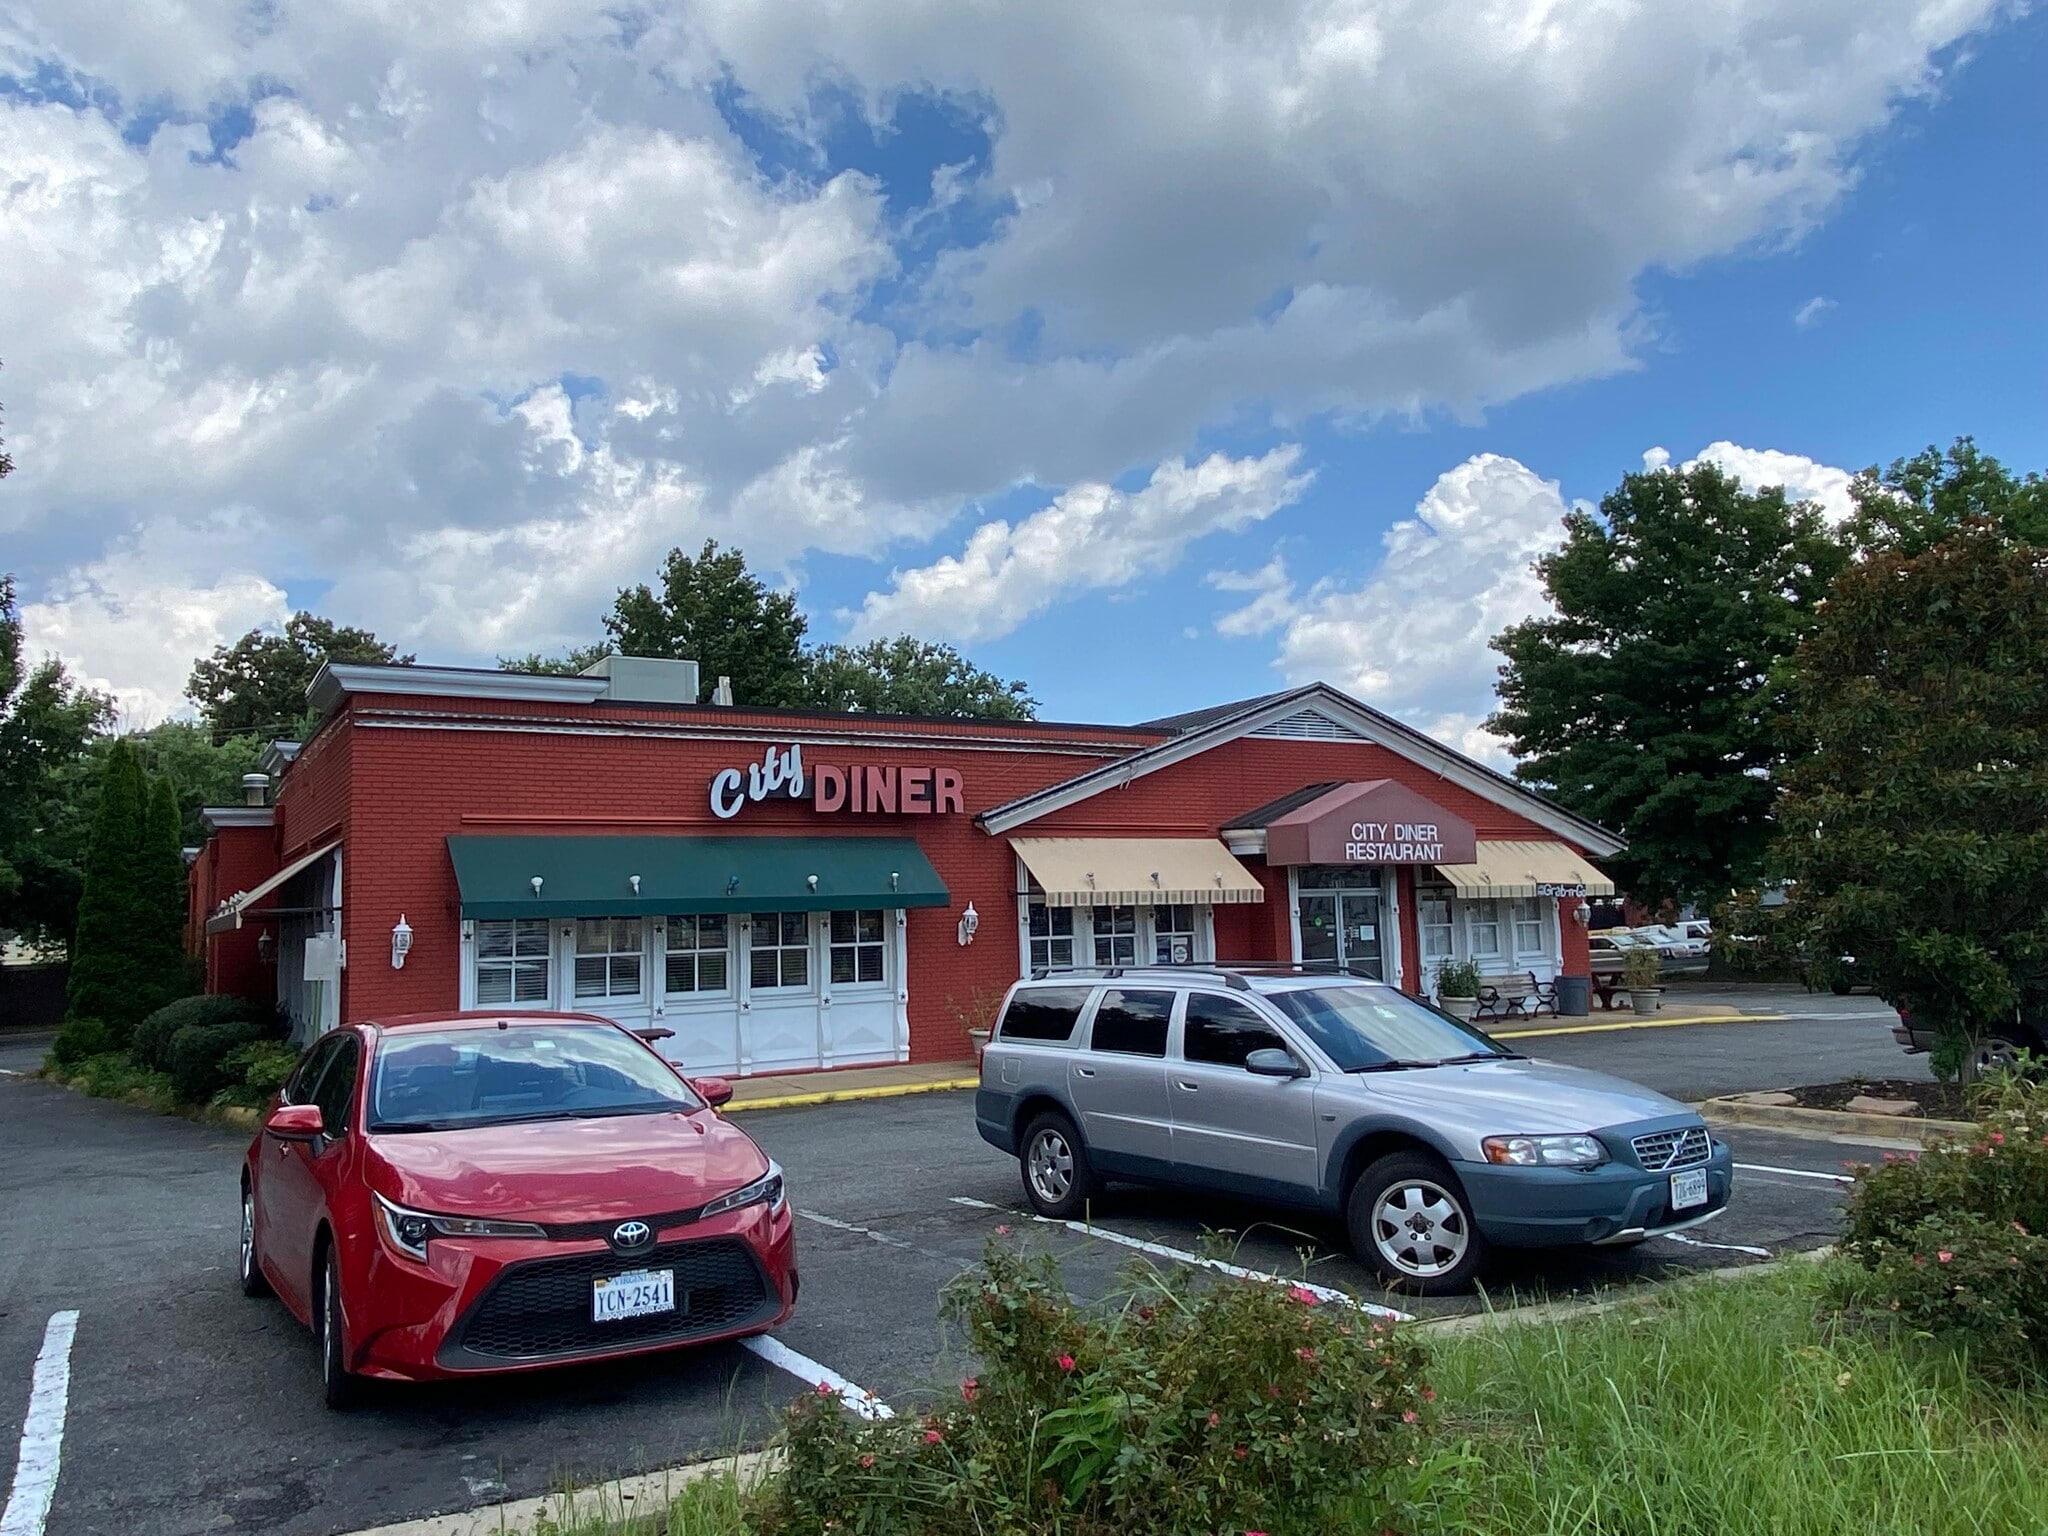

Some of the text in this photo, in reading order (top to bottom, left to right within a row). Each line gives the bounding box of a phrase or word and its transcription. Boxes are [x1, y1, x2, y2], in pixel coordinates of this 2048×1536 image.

[710, 744, 965, 819] City DINER
[1351, 823, 1438, 842] CITY DINER
[1345, 842, 1444, 860] RESTAURANT
[598, 1283, 670, 1314] YCN-2541
